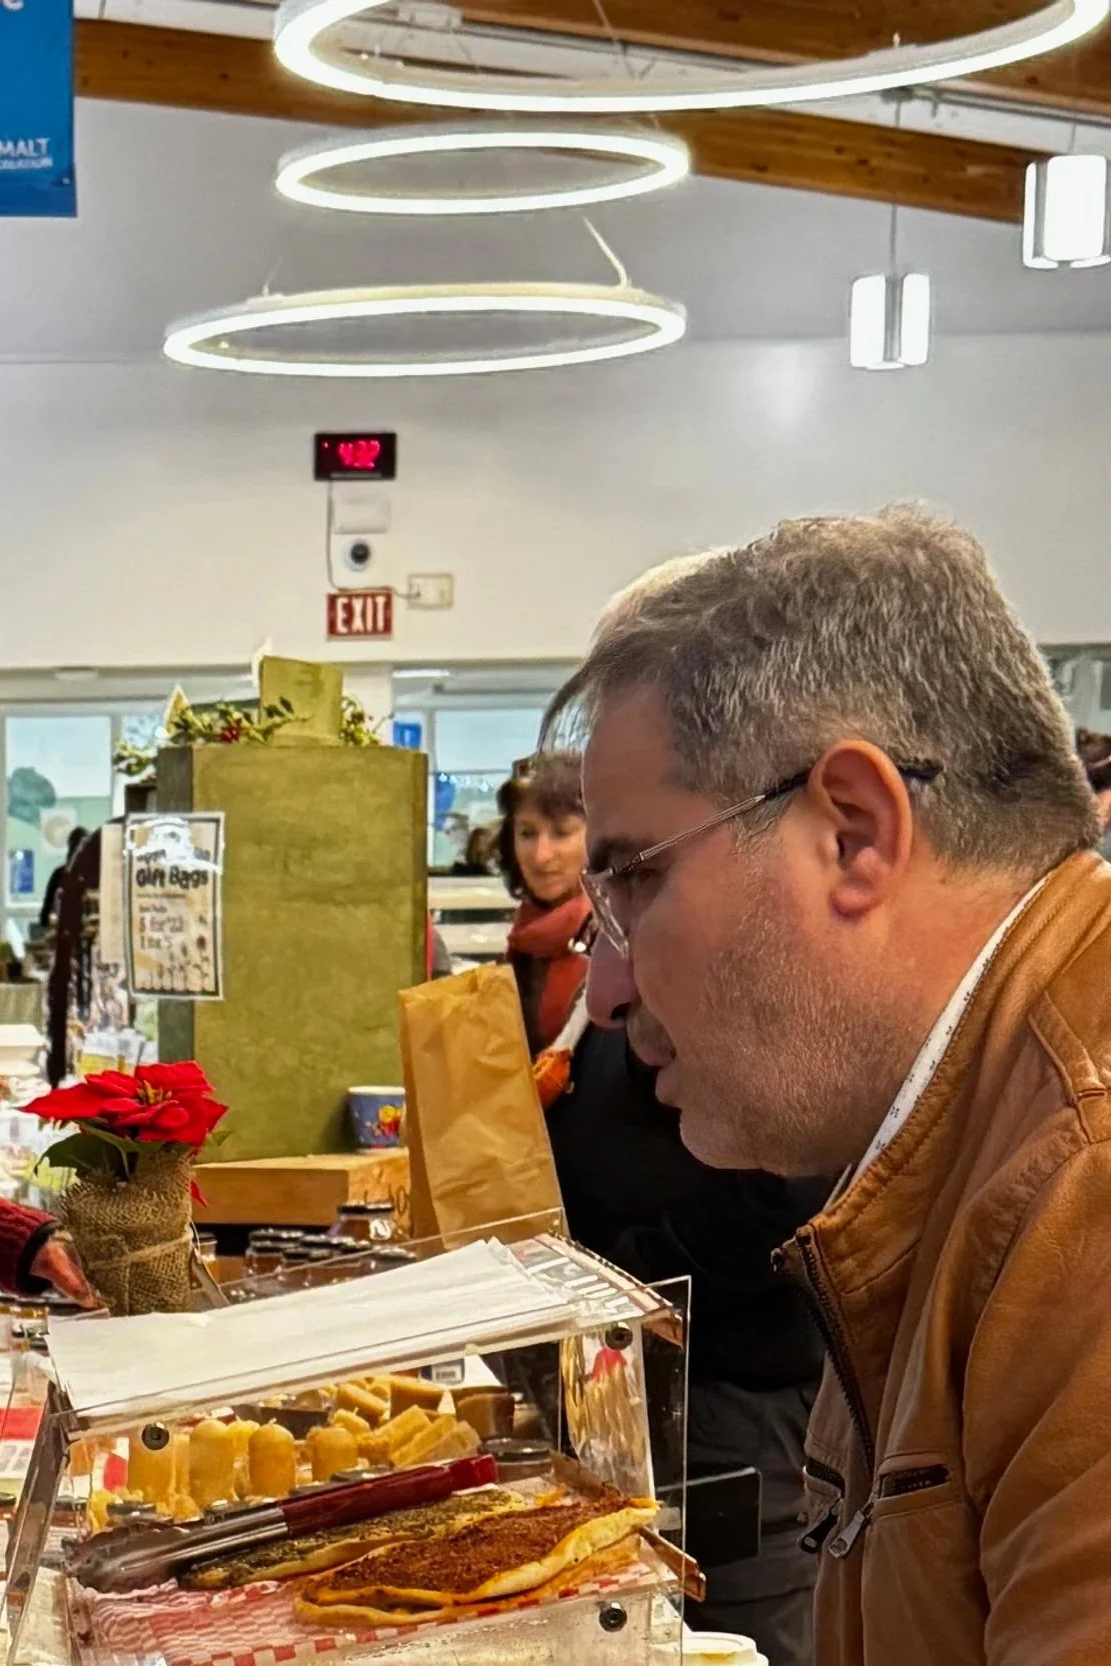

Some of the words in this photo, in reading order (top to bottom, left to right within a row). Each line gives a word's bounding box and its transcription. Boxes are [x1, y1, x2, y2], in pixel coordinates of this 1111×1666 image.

[336, 597, 387, 634] EXIT
[136, 866, 166, 888] Gift
[168, 865, 209, 889] Bags
